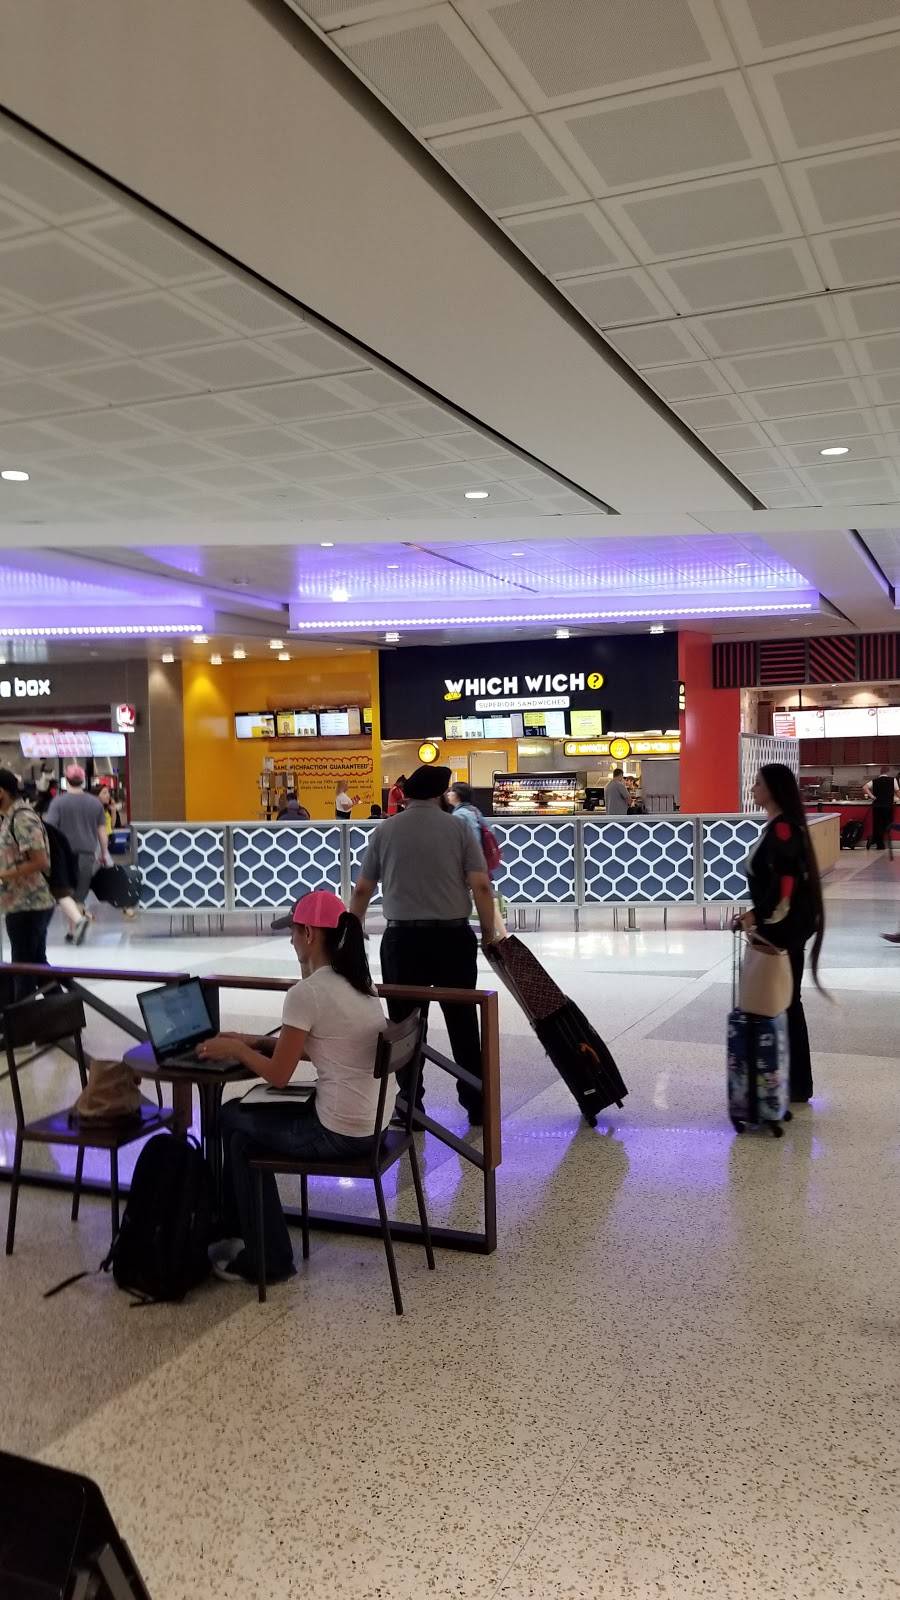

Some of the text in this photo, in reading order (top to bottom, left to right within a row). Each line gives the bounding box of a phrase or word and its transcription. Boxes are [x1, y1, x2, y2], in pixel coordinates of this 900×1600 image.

[15, 677, 51, 697] box
[444, 676, 519, 697] WHICH
[478, 698, 566, 709] SUPERIOR SANDWICHES
